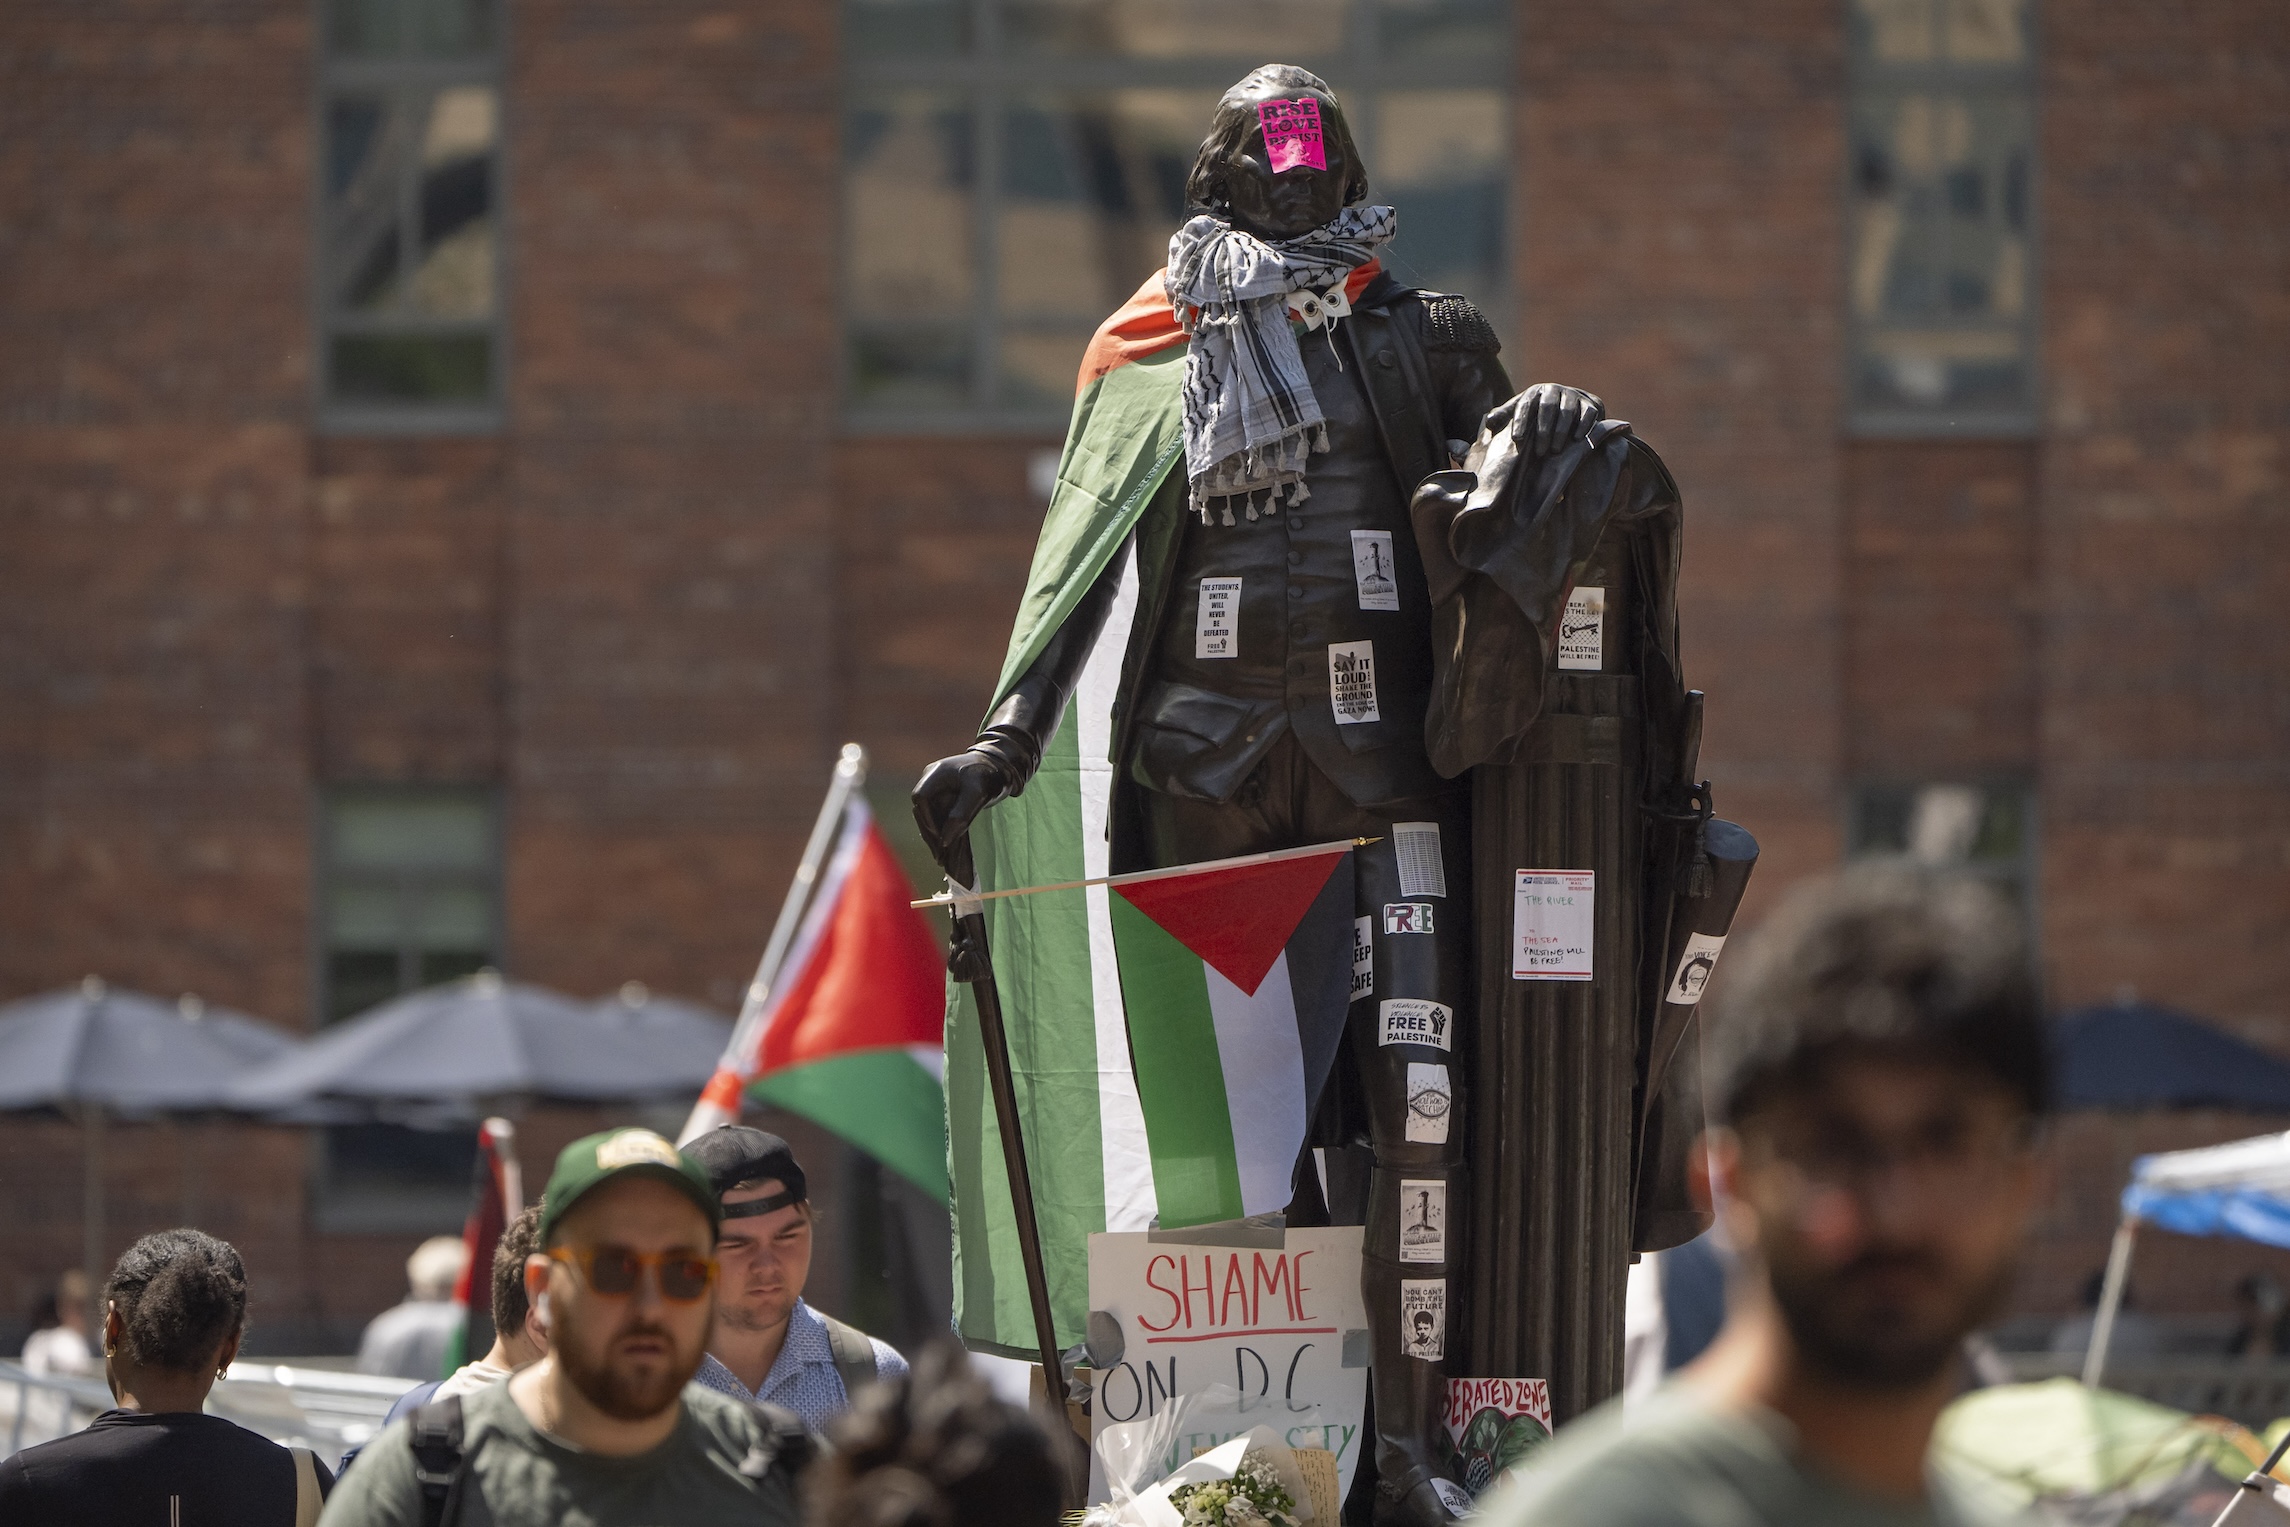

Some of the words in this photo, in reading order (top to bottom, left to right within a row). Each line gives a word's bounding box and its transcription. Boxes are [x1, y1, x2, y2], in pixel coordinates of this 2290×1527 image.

[1262, 103, 1316, 119] RISE
[1265, 118, 1318, 134] LOVE
[1560, 645, 1600, 653] PALESTINE
[1334, 660, 1356, 673] SAY
[1359, 658, 1370, 670] IT
[1335, 671, 1366, 685] LOUD
[1335, 684, 1359, 693] SHAKE
[1335, 690, 1373, 702] GROUND
[1337, 706, 1357, 715] GAZA
[1357, 705, 1376, 713] NOW!
[1524, 895, 1543, 905] THE
[1546, 896, 1574, 905] RIVER
[1522, 937, 1539, 945] THE
[1354, 945, 1371, 962] EEP
[1388, 1017, 1426, 1031] FREE
[1387, 1032, 1441, 1045] PALESTINE
[1137, 1250, 1318, 1331] SHAME
[1101, 1355, 1176, 1421] ON
[1516, 1381, 1550, 1420] ZONE
